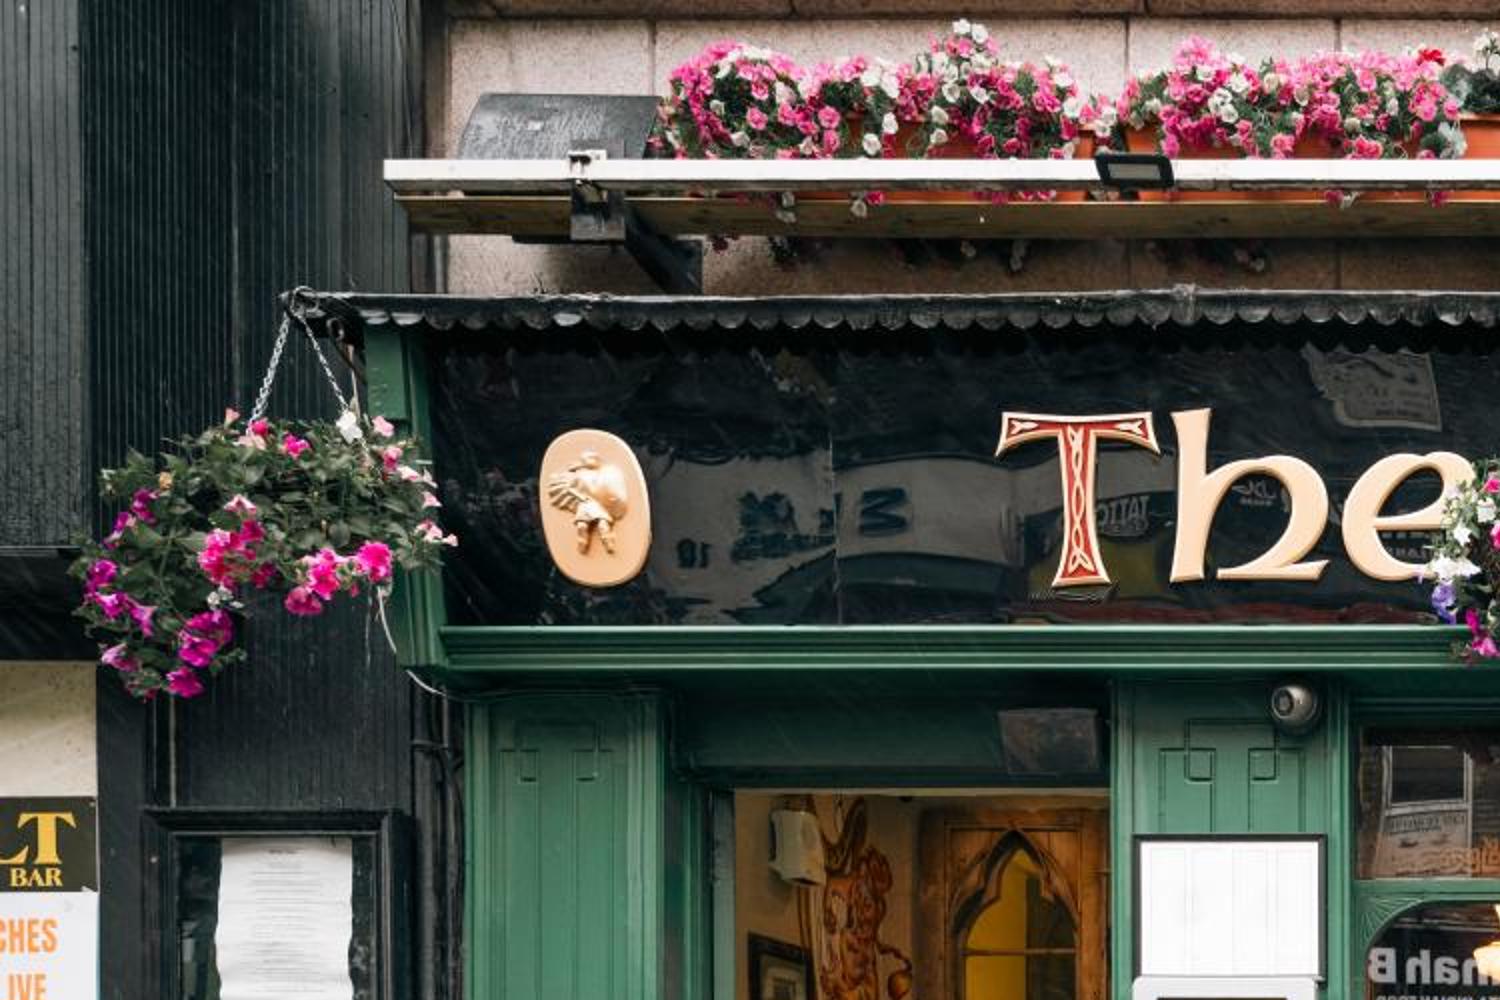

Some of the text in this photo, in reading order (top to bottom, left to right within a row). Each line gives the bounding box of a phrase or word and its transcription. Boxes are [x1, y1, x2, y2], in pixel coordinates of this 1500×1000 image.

[995, 407, 1478, 588] The
[0, 812, 77, 865] T
[9, 867, 63, 887] BAR
